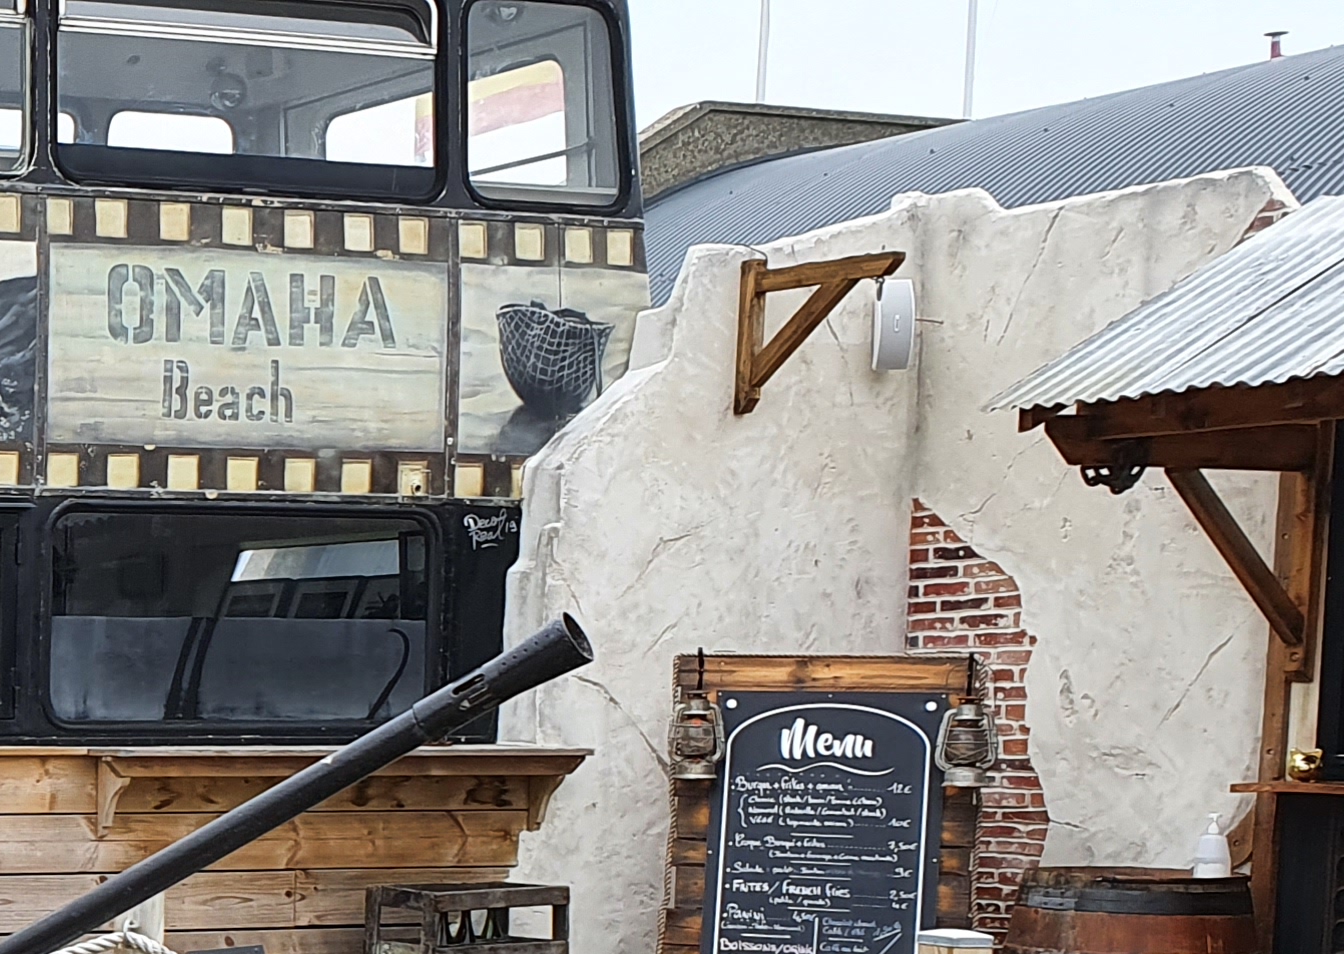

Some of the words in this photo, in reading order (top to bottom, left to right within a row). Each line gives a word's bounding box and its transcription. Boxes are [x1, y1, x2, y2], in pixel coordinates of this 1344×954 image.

[106, 262, 397, 350] OMAHA
[161, 358, 295, 424] Beach
[780, 717, 873, 760] Menu
